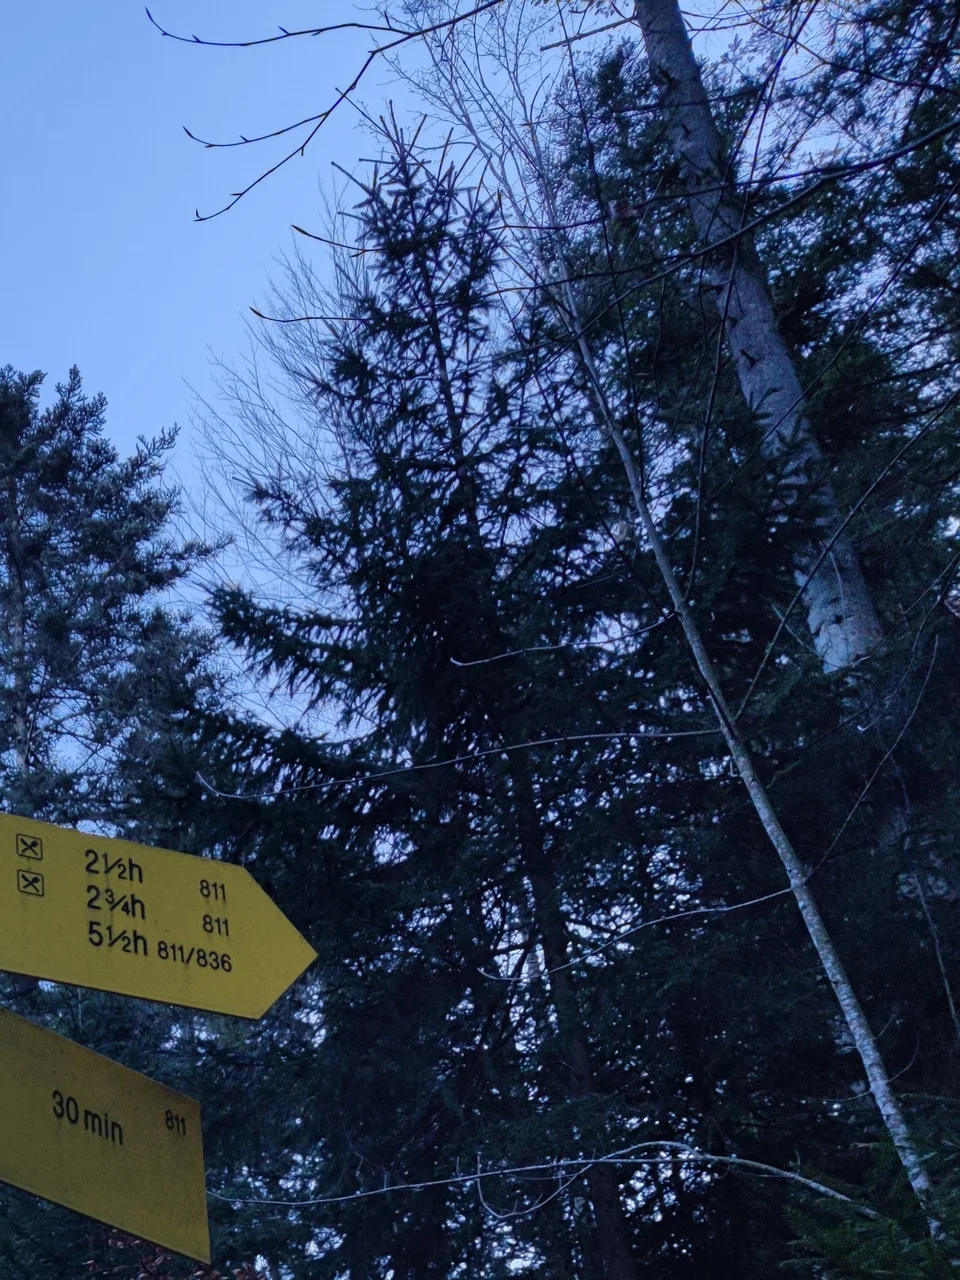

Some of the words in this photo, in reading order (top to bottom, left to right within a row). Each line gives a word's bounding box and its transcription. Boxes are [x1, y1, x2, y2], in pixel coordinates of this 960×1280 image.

[200, 879, 226, 902] 811
[202, 914, 230, 938] 811
[157, 941, 233, 973] 811/836
[164, 1109, 187, 1137] 811
